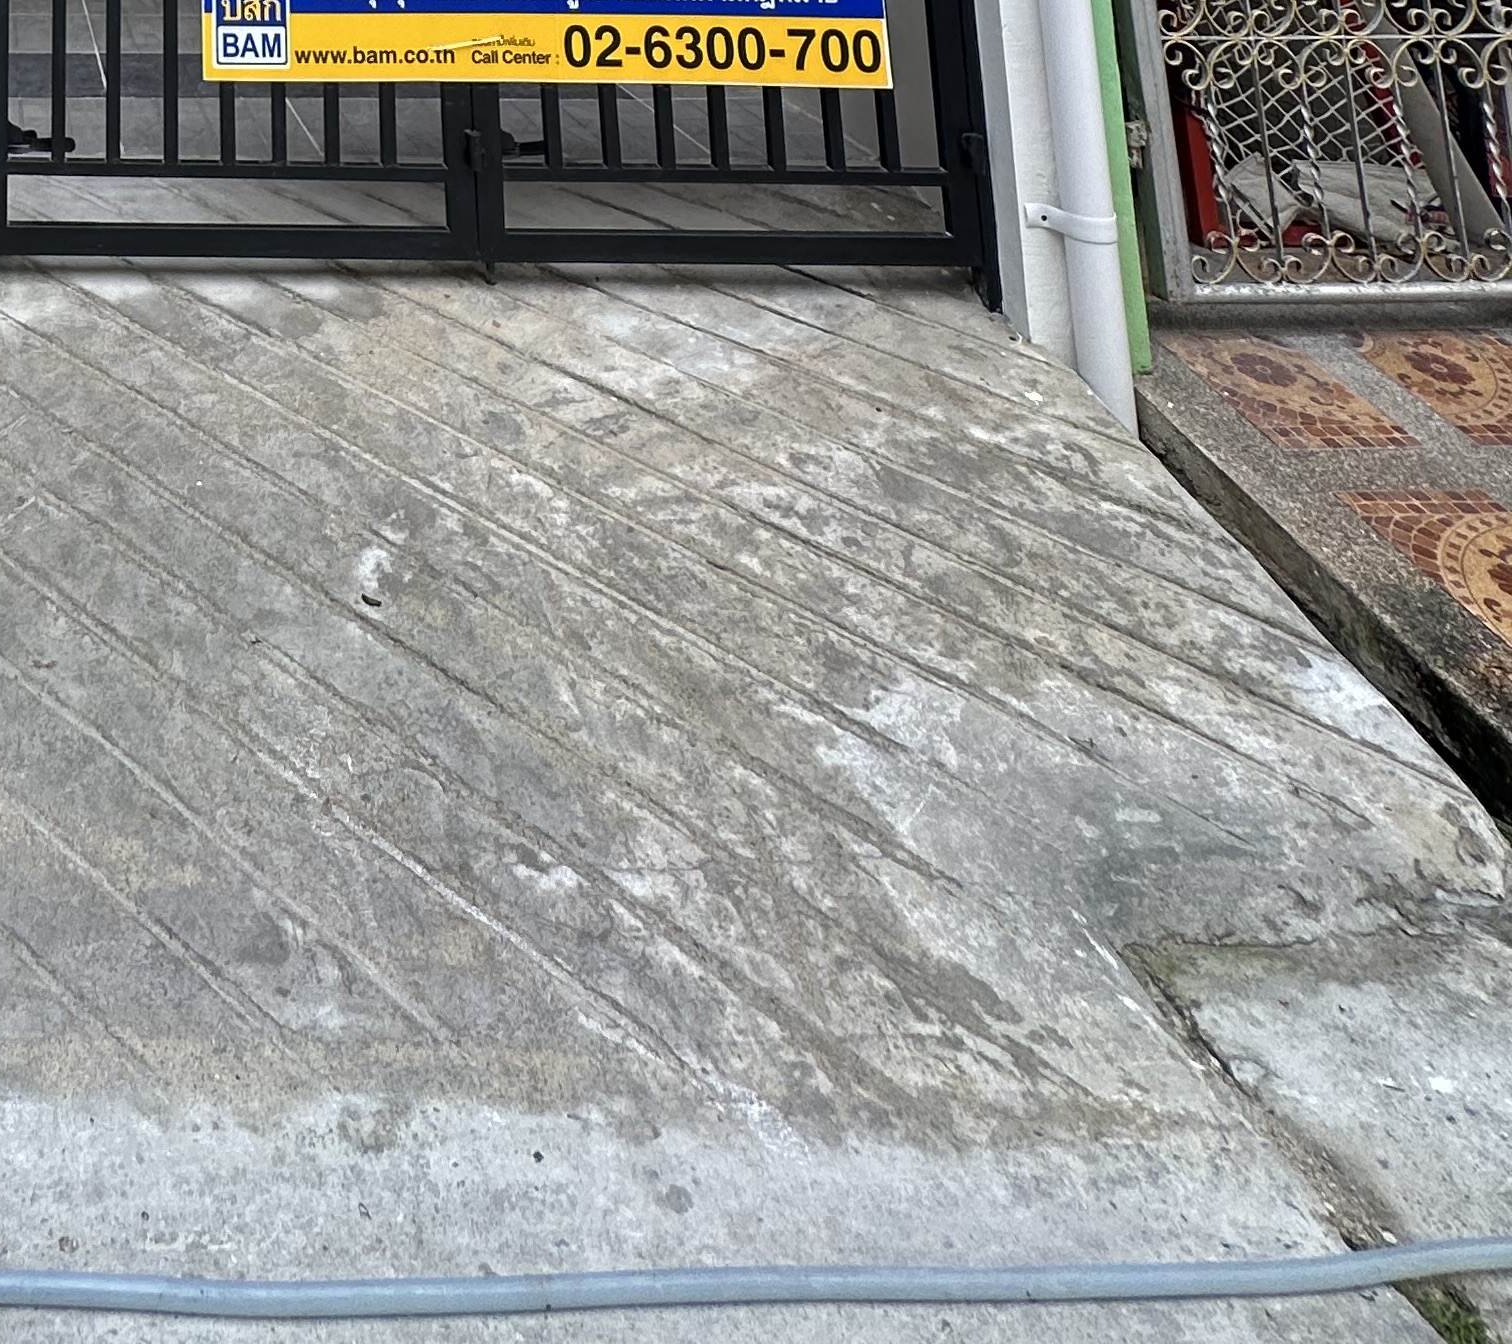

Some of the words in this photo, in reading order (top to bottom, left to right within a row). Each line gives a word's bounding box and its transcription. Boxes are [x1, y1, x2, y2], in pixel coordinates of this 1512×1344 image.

[222, 32, 282, 59] BAM
[294, 46, 455, 64] www.bam.co.th
[471, 50, 499, 64] Call
[564, 24, 882, 73] 02-6300-700
